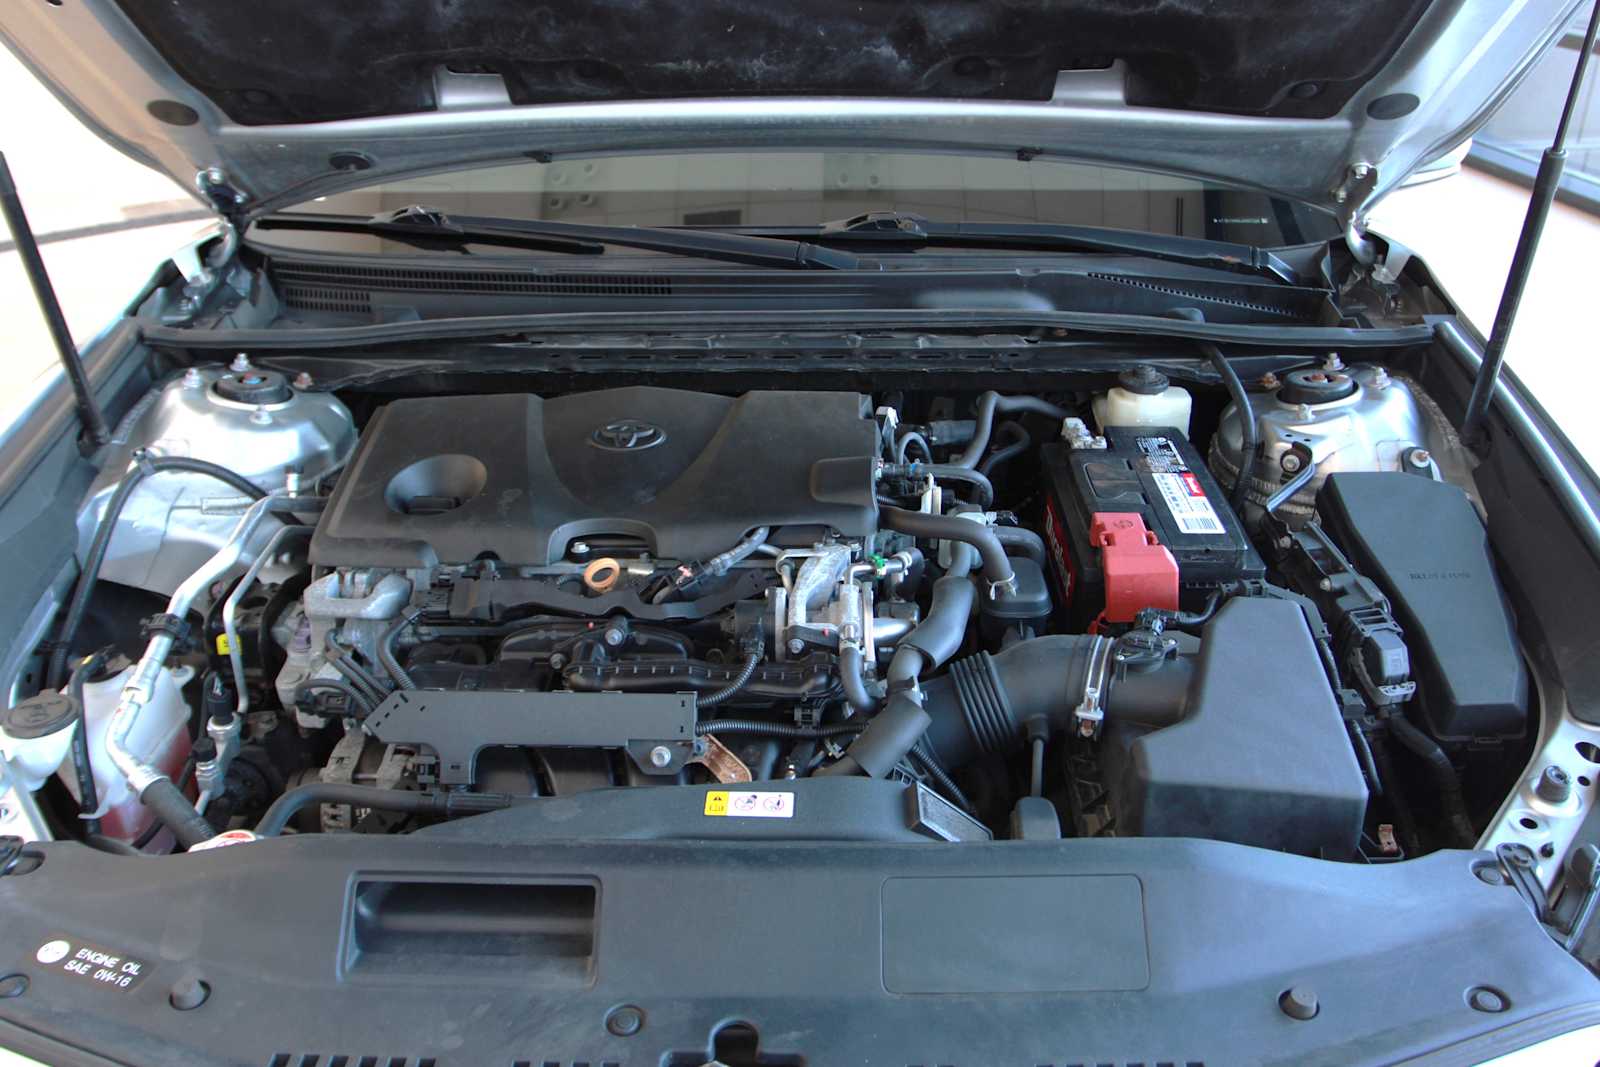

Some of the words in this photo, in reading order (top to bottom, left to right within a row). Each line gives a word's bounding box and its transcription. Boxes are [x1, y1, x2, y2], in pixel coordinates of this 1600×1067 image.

[63, 959, 92, 975] SAE
[93, 968, 132, 987] 0W-16
[75, 948, 121, 968] ENGINE
[121, 962, 142, 976] OIL
